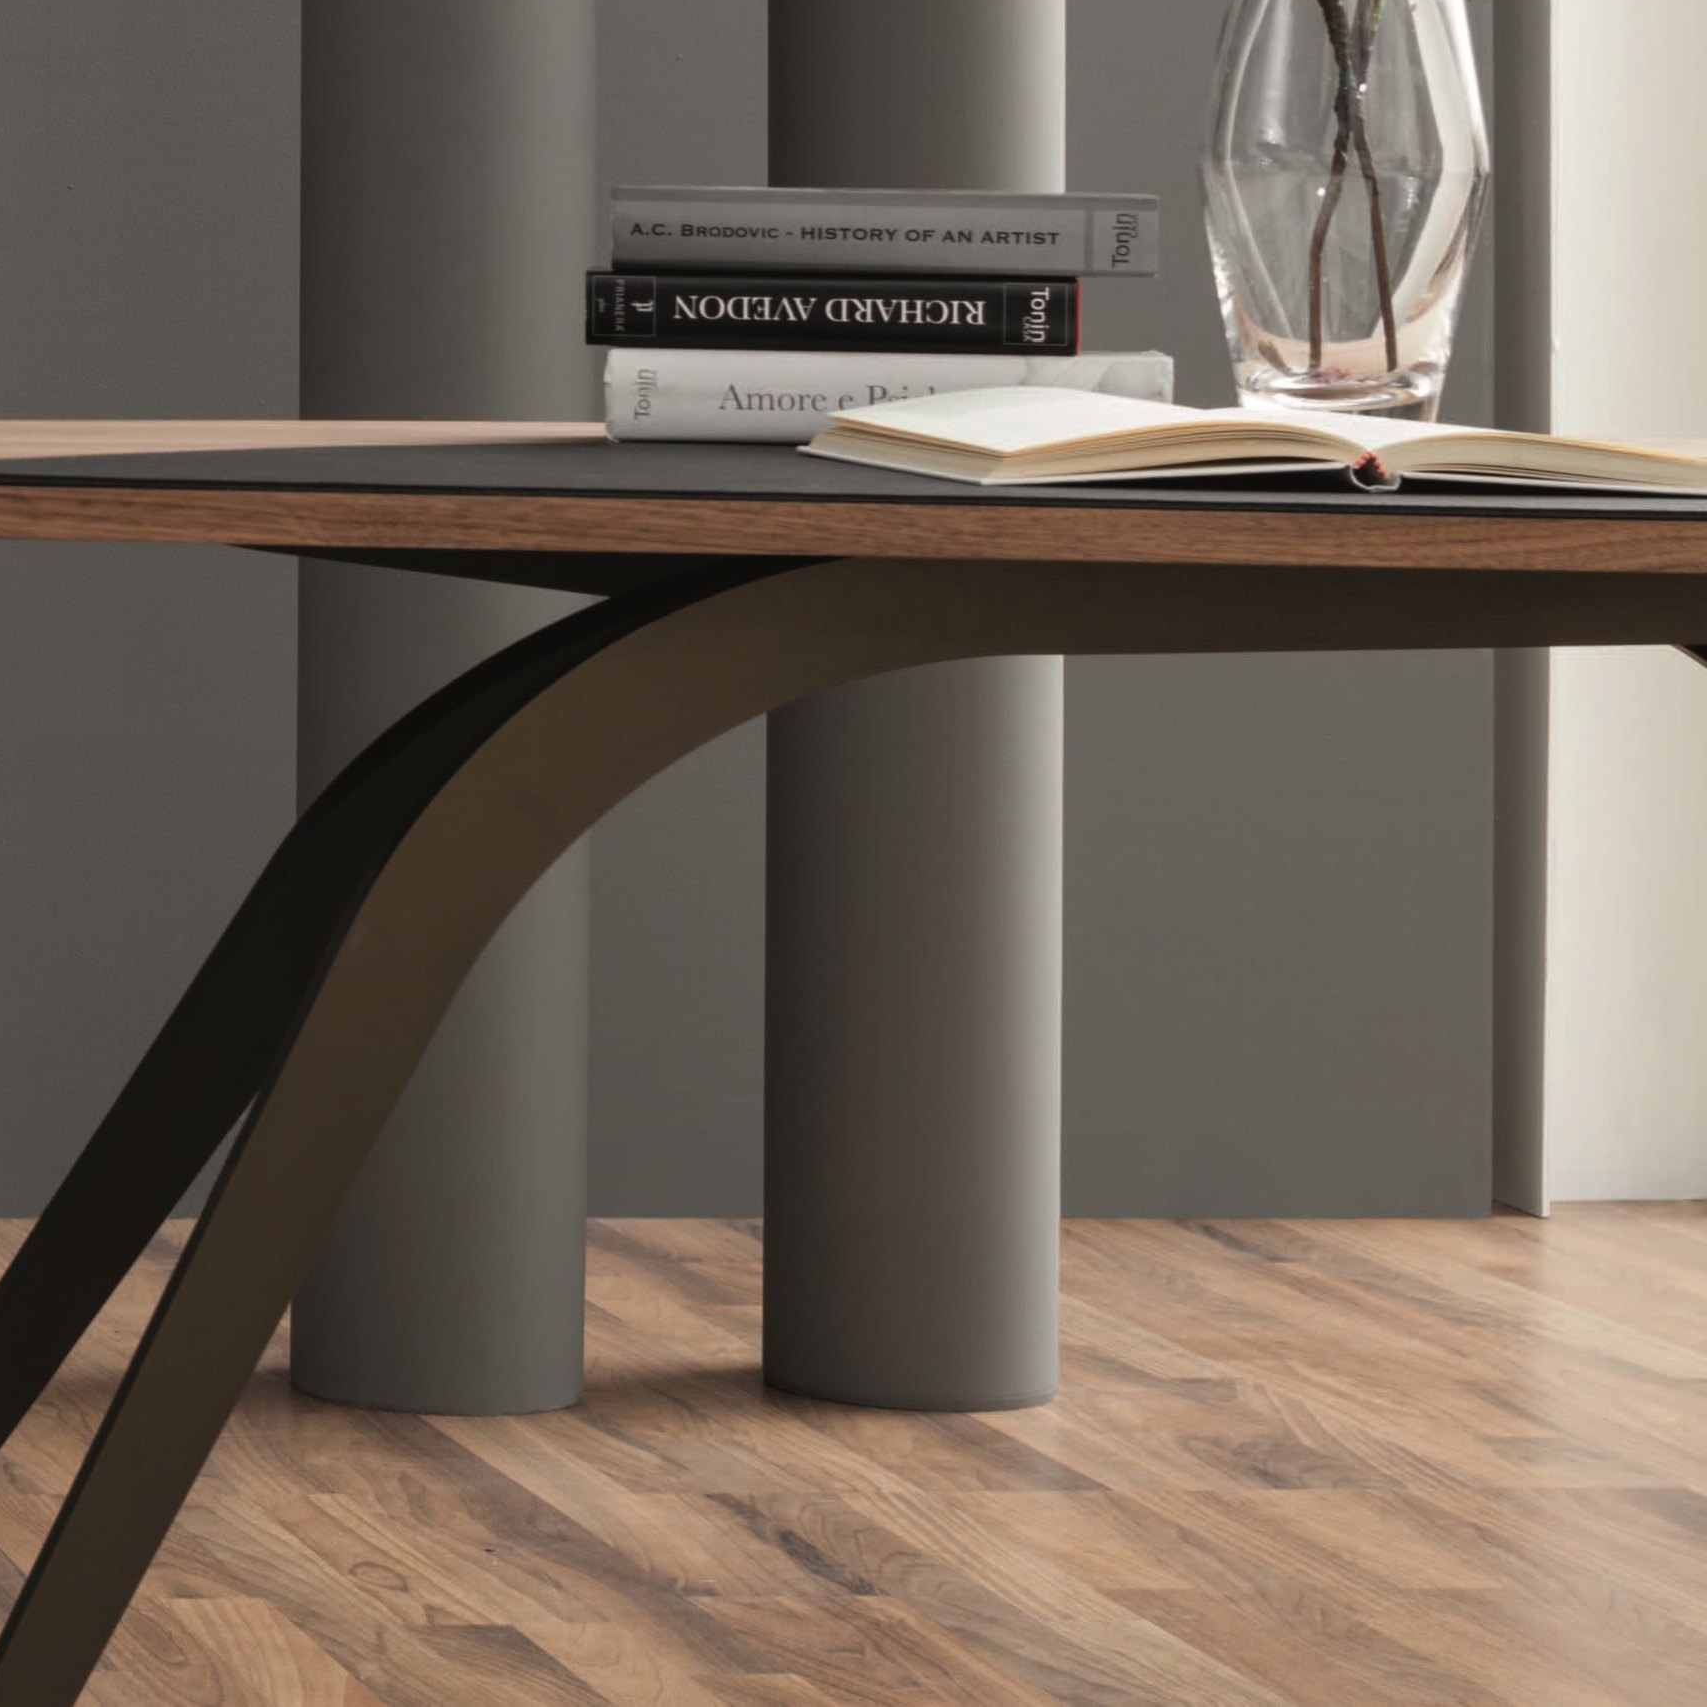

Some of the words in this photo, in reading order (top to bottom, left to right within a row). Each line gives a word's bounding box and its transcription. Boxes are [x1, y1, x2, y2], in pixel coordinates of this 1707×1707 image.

[800, 226, 897, 241] HISTORY
[904, 228, 935, 242] OF
[942, 229, 972, 243] AN
[981, 230, 1059, 245] ARTIST
[1111, 213, 1132, 268] Tonin
[673, 295, 816, 321] AVEDON
[825, 298, 984, 324] RICHARD
[1028, 286, 1050, 342] Tonin
[632, 368, 657, 420] Tonin
[718, 382, 827, 412] Amore
[837, 394, 854, 410] e
